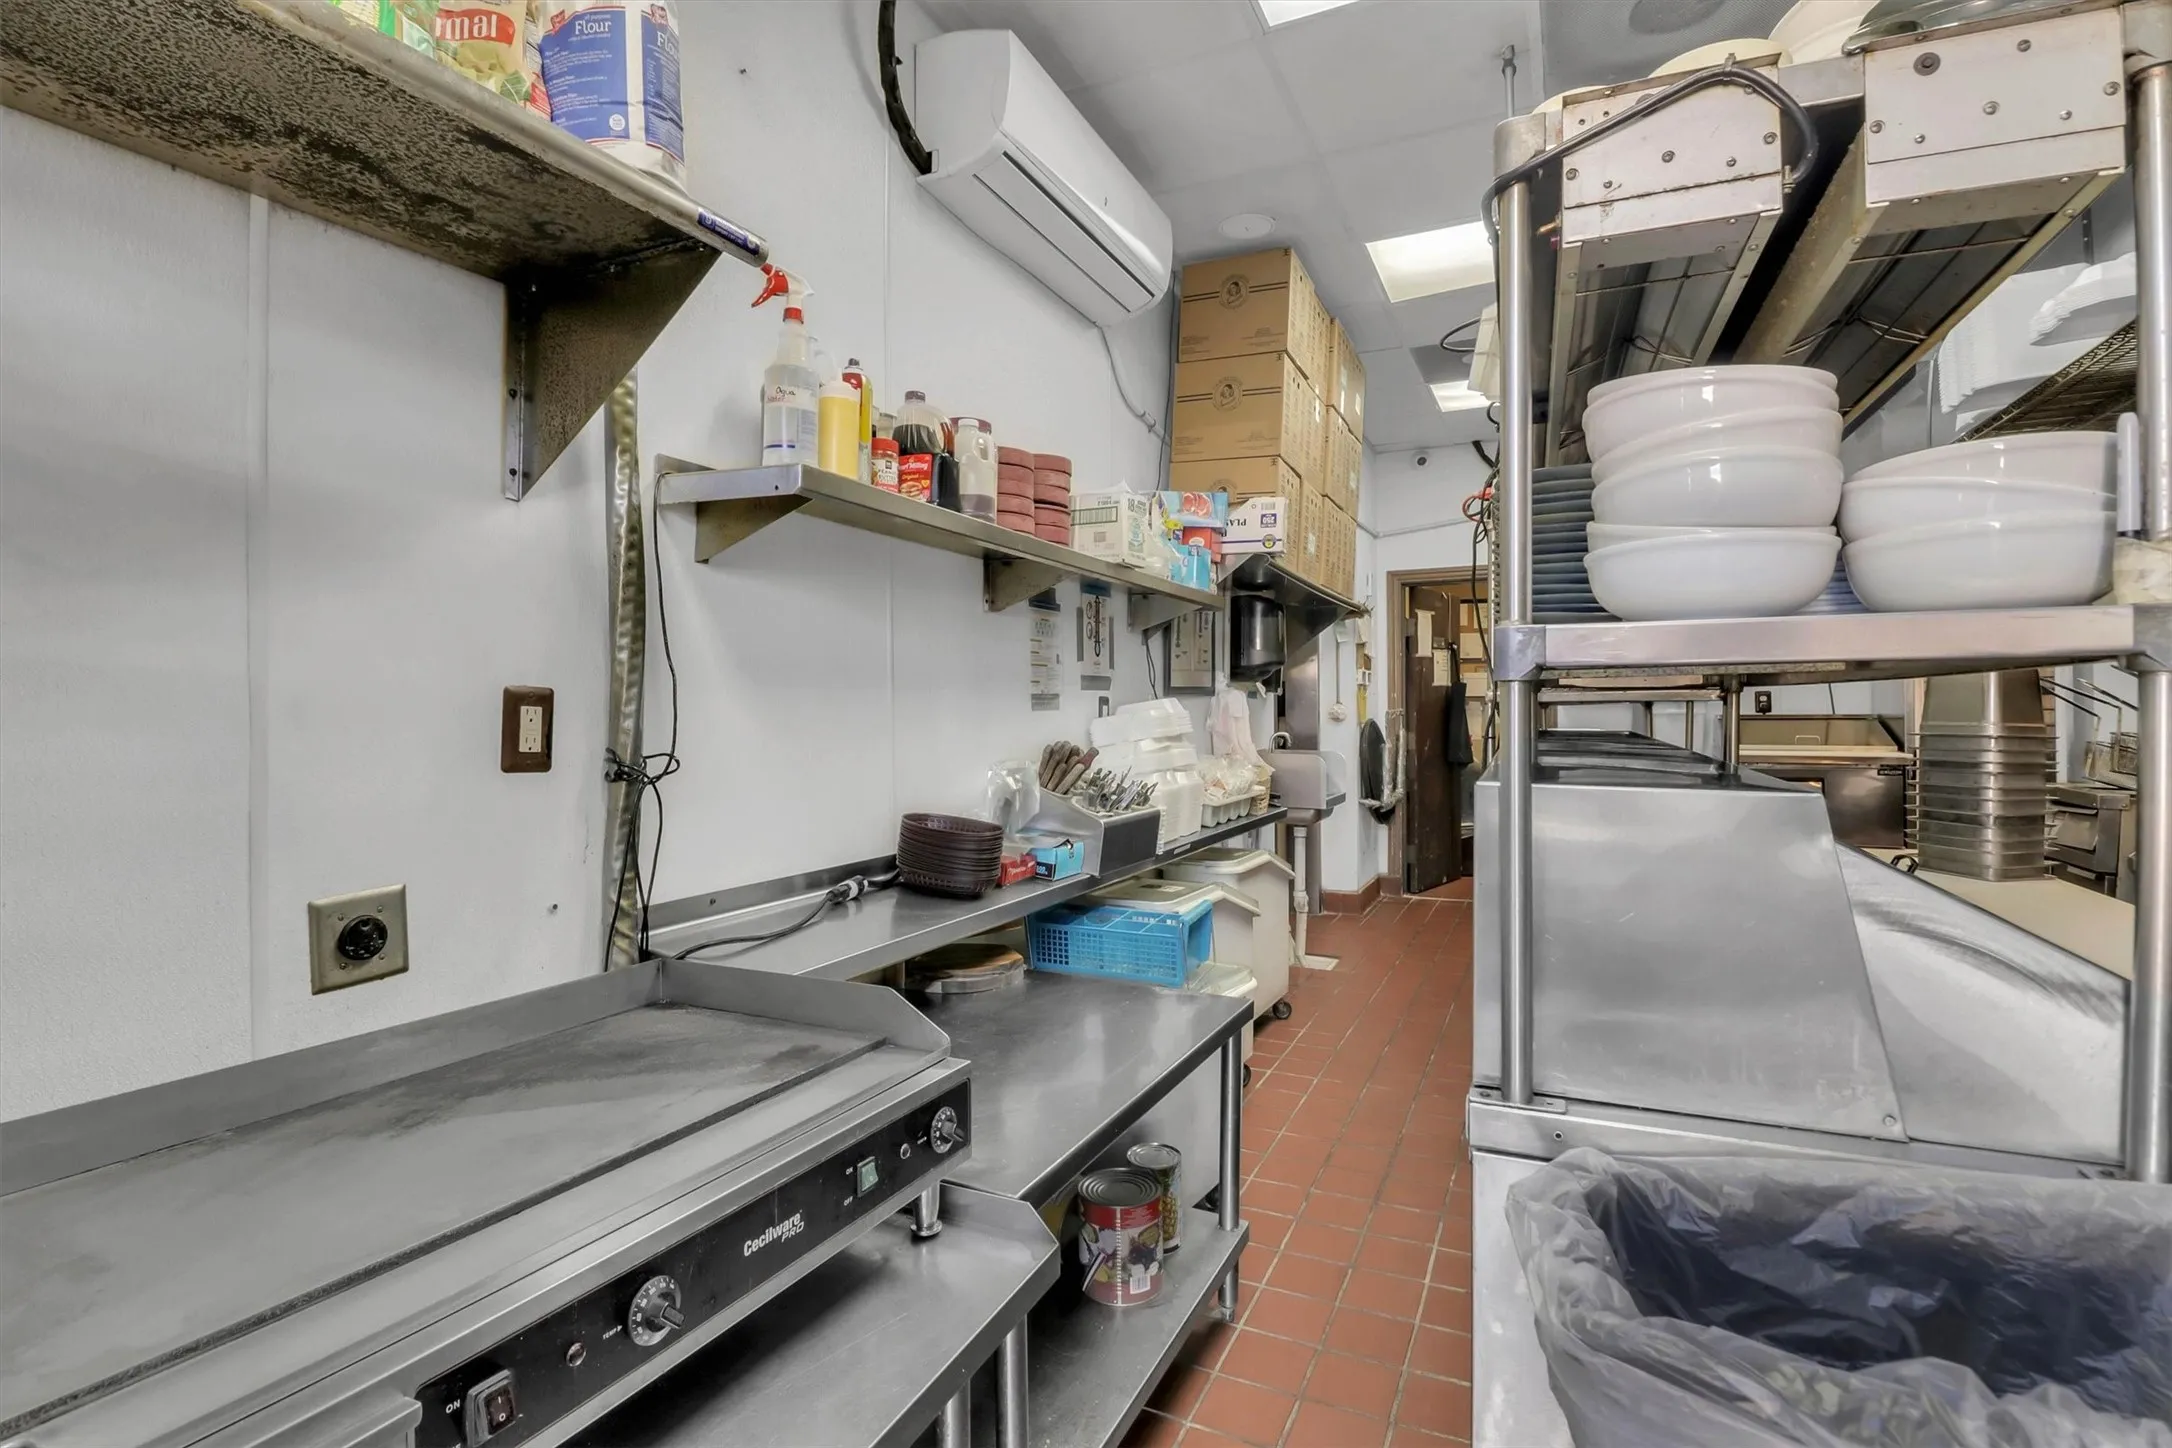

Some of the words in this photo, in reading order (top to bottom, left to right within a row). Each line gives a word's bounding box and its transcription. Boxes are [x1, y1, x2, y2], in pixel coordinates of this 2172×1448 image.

[575, 20, 612, 35] Flour
[743, 1211, 801, 1257] Cecilware
[781, 1221, 805, 1244] PRO
[445, 1398, 461, 1414] ON
